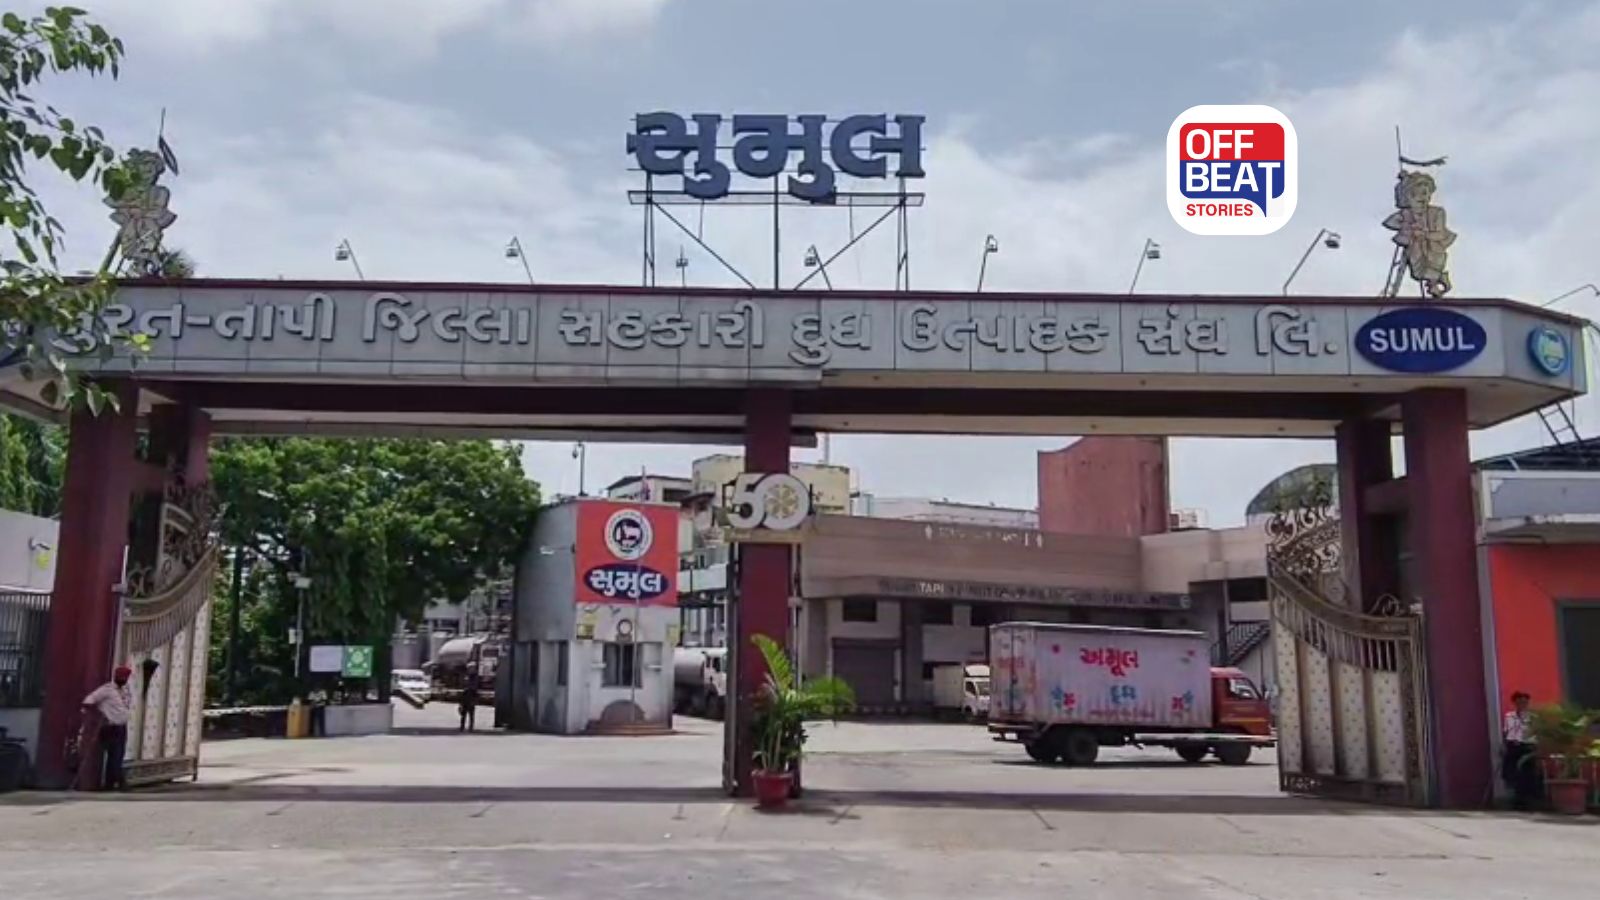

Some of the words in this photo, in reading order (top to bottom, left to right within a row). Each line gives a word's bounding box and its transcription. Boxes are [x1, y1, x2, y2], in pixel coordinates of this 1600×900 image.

[626, 112, 926, 204] સુમુલ
[363, 292, 531, 345] જિલ્લા
[558, 300, 767, 351] સહકારી
[902, 304, 1110, 354] ઉત્પાદક
[1137, 304, 1229, 356] સંઘ
[1254, 304, 1340, 357] લિ.
[1369, 326, 1475, 354] SUMUL
[589, 569, 662, 598] સુમુલ
[919, 581, 945, 594] TAPI
